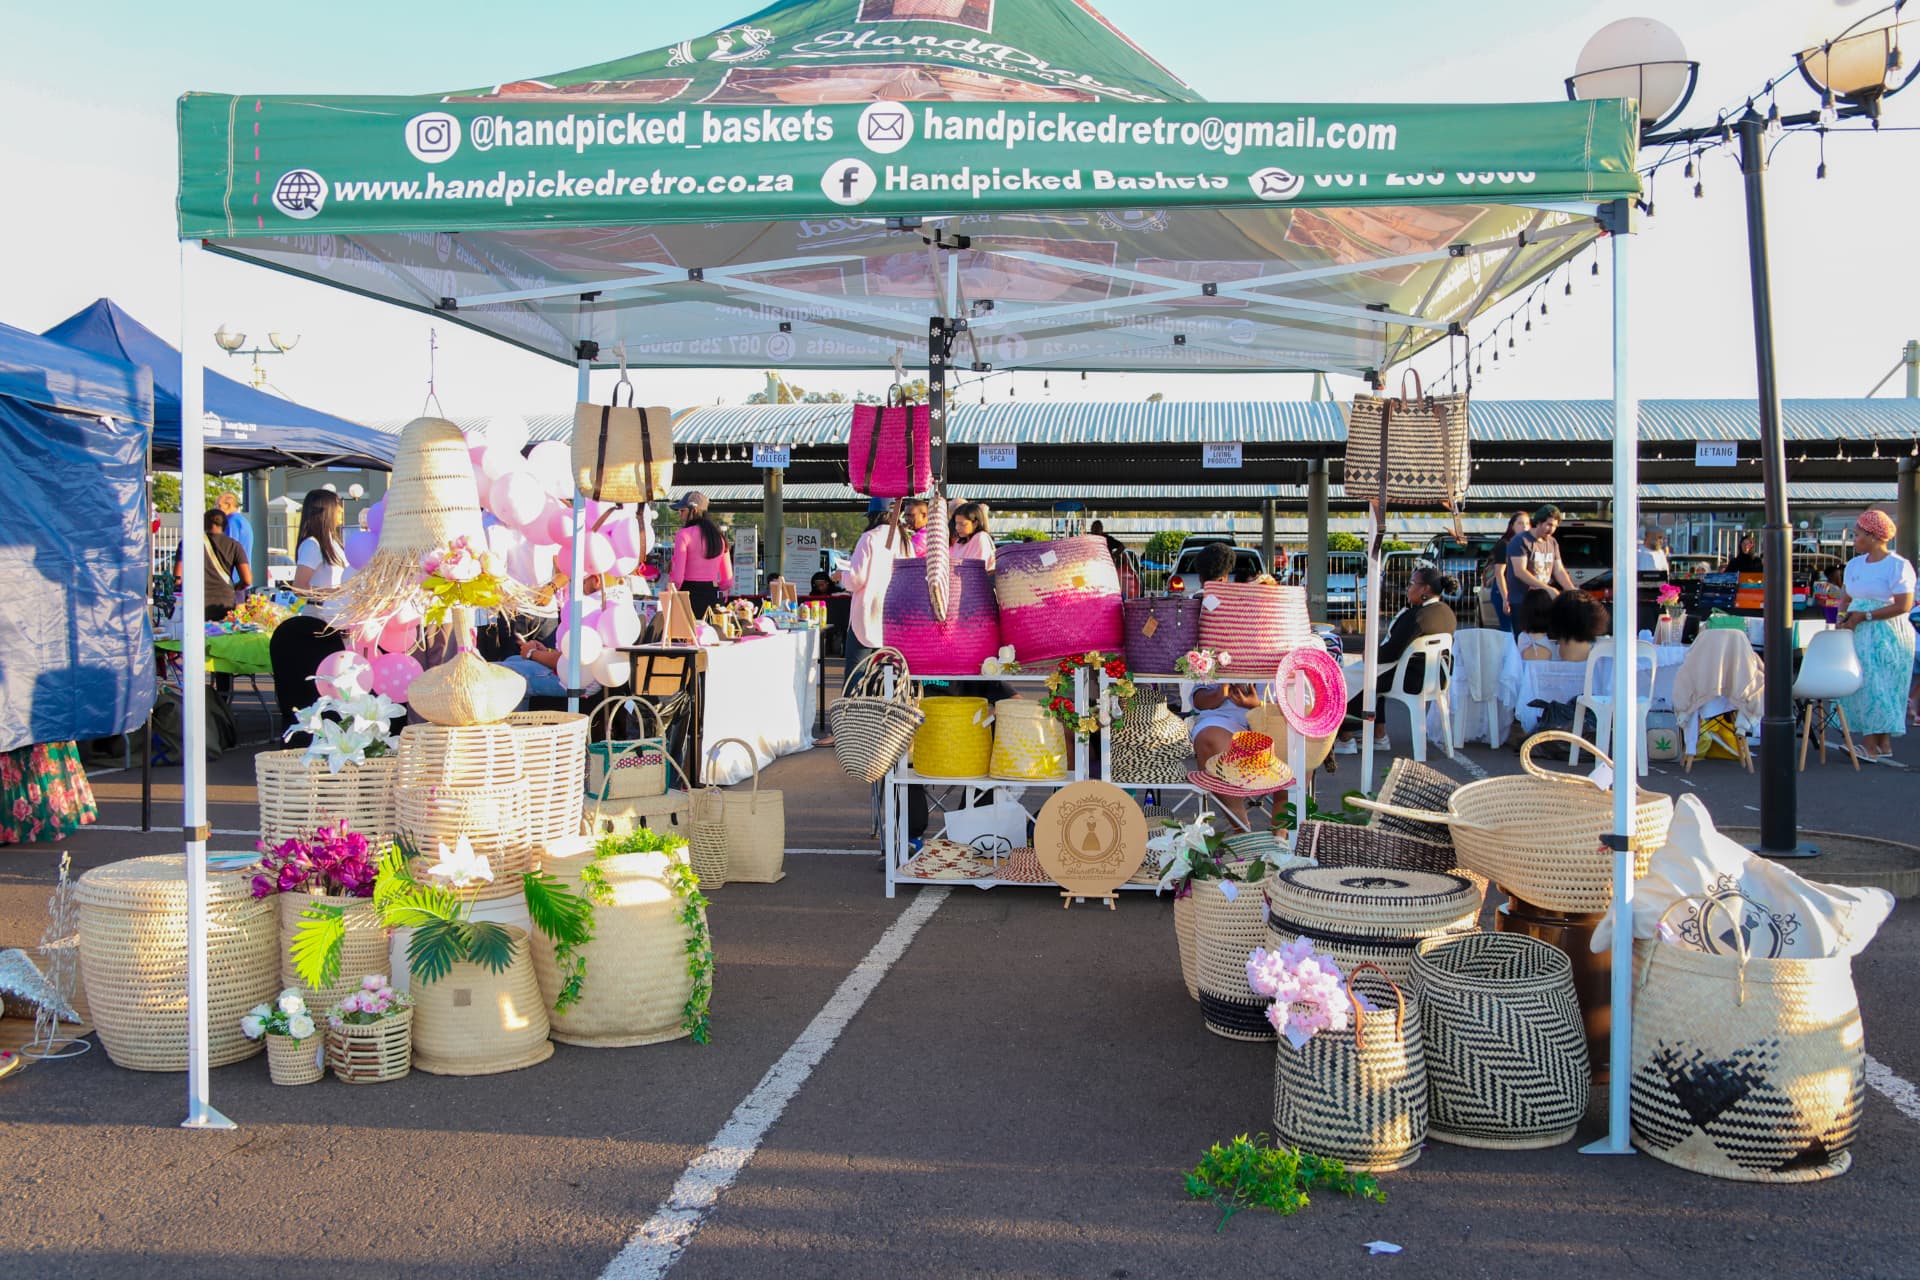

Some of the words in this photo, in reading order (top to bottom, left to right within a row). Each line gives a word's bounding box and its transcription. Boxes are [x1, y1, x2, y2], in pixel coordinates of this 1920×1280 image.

[470, 109, 834, 153] @handpicked_baskets
[923, 107, 1397, 155] handpickedretro@gmail.com
[884, 165, 1082, 198] Handpicked
[333, 171, 794, 206] www.handpickedretro.co.za
[1209, 444, 1235, 452] FOREVER
[1700, 447, 1733, 457] LE'TANG
[755, 454, 787, 463] COLLEGE
[989, 455, 1006, 463] SPCA
[1207, 457, 1237, 465] PRODUCTS
[797, 535, 817, 545] RSA
